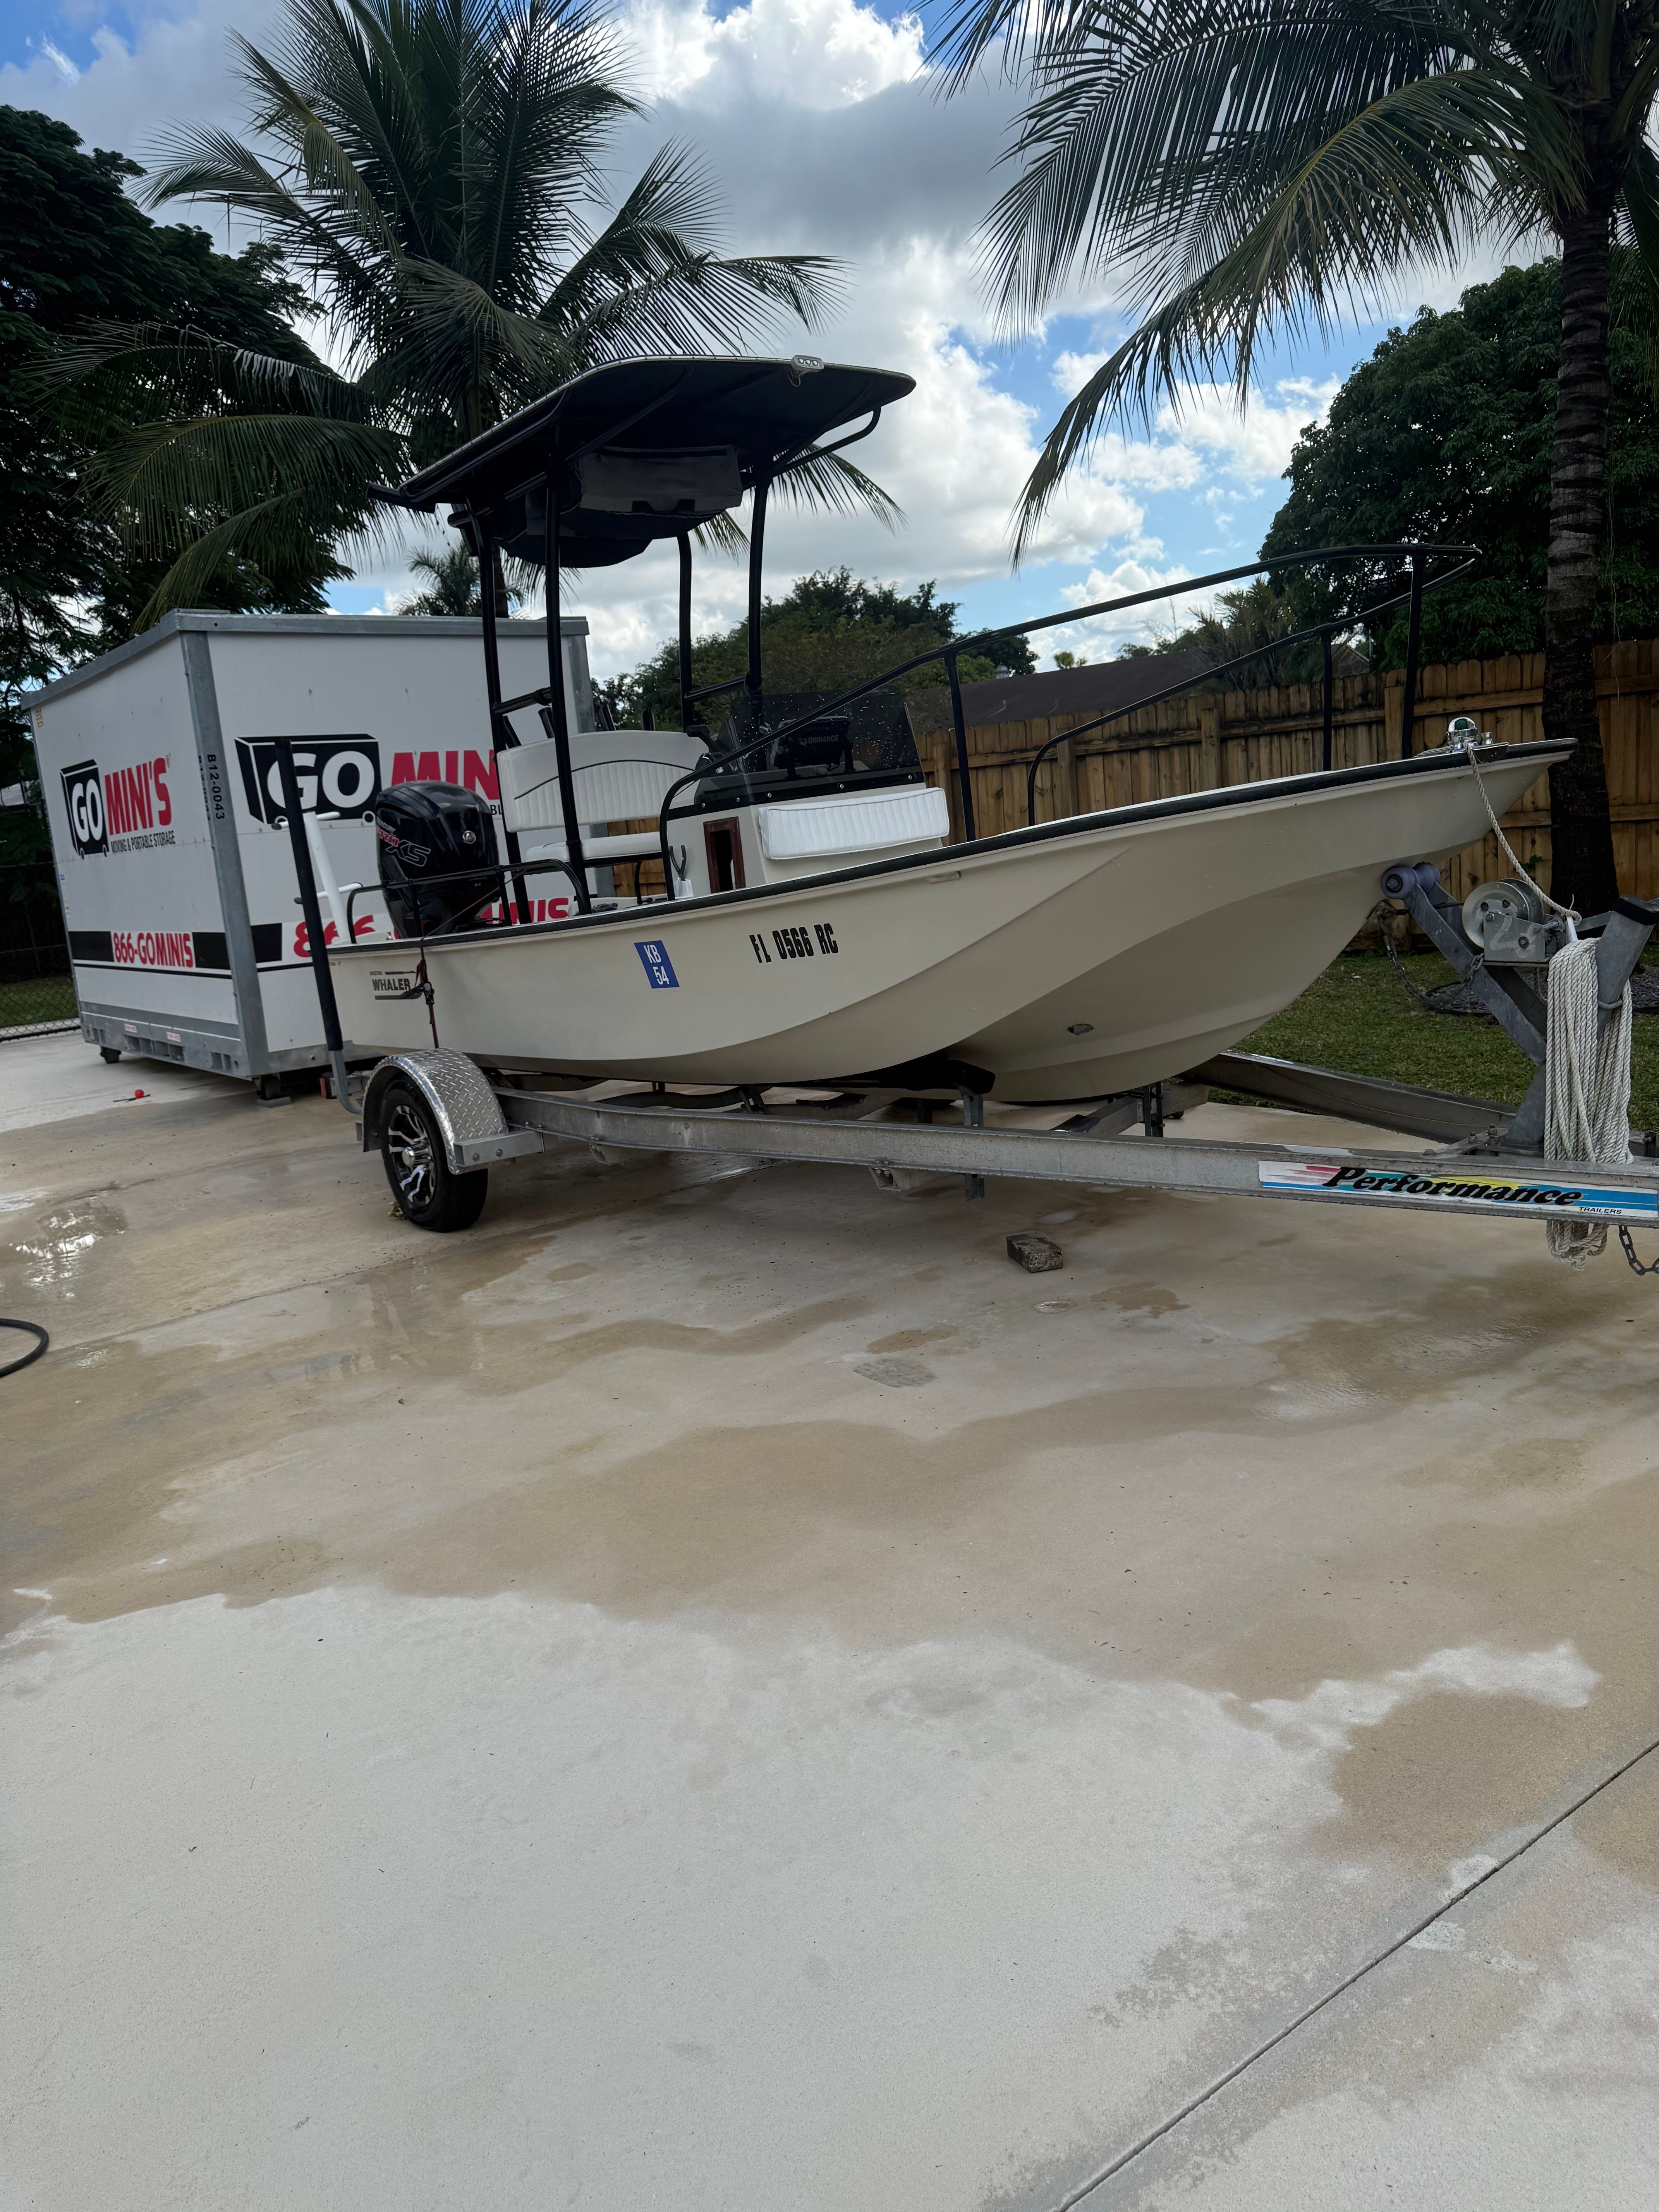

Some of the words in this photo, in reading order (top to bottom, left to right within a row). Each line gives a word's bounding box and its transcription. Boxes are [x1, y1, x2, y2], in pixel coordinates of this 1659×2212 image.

[207, 754, 225, 819] B12-0043
[267, 750, 374, 810] GO
[72, 779, 103, 842] GO
[105, 757, 172, 835] MINI'S
[110, 838, 127, 853] MOVING
[127, 838, 131, 851] &
[131, 834, 153, 850] PORTABLE
[153, 830, 176, 847] STORAGE
[385, 840, 431, 867] XS
[113, 932, 193, 968] 866-GOMINIS
[643, 945, 661, 963] KB
[749, 934, 772, 963] FL
[772, 927, 814, 960] 0566
[814, 923, 839, 954] RC
[372, 979, 411, 991] WHALER
[653, 966, 670, 985] 54
[1322, 1166, 1583, 1205] Performance
